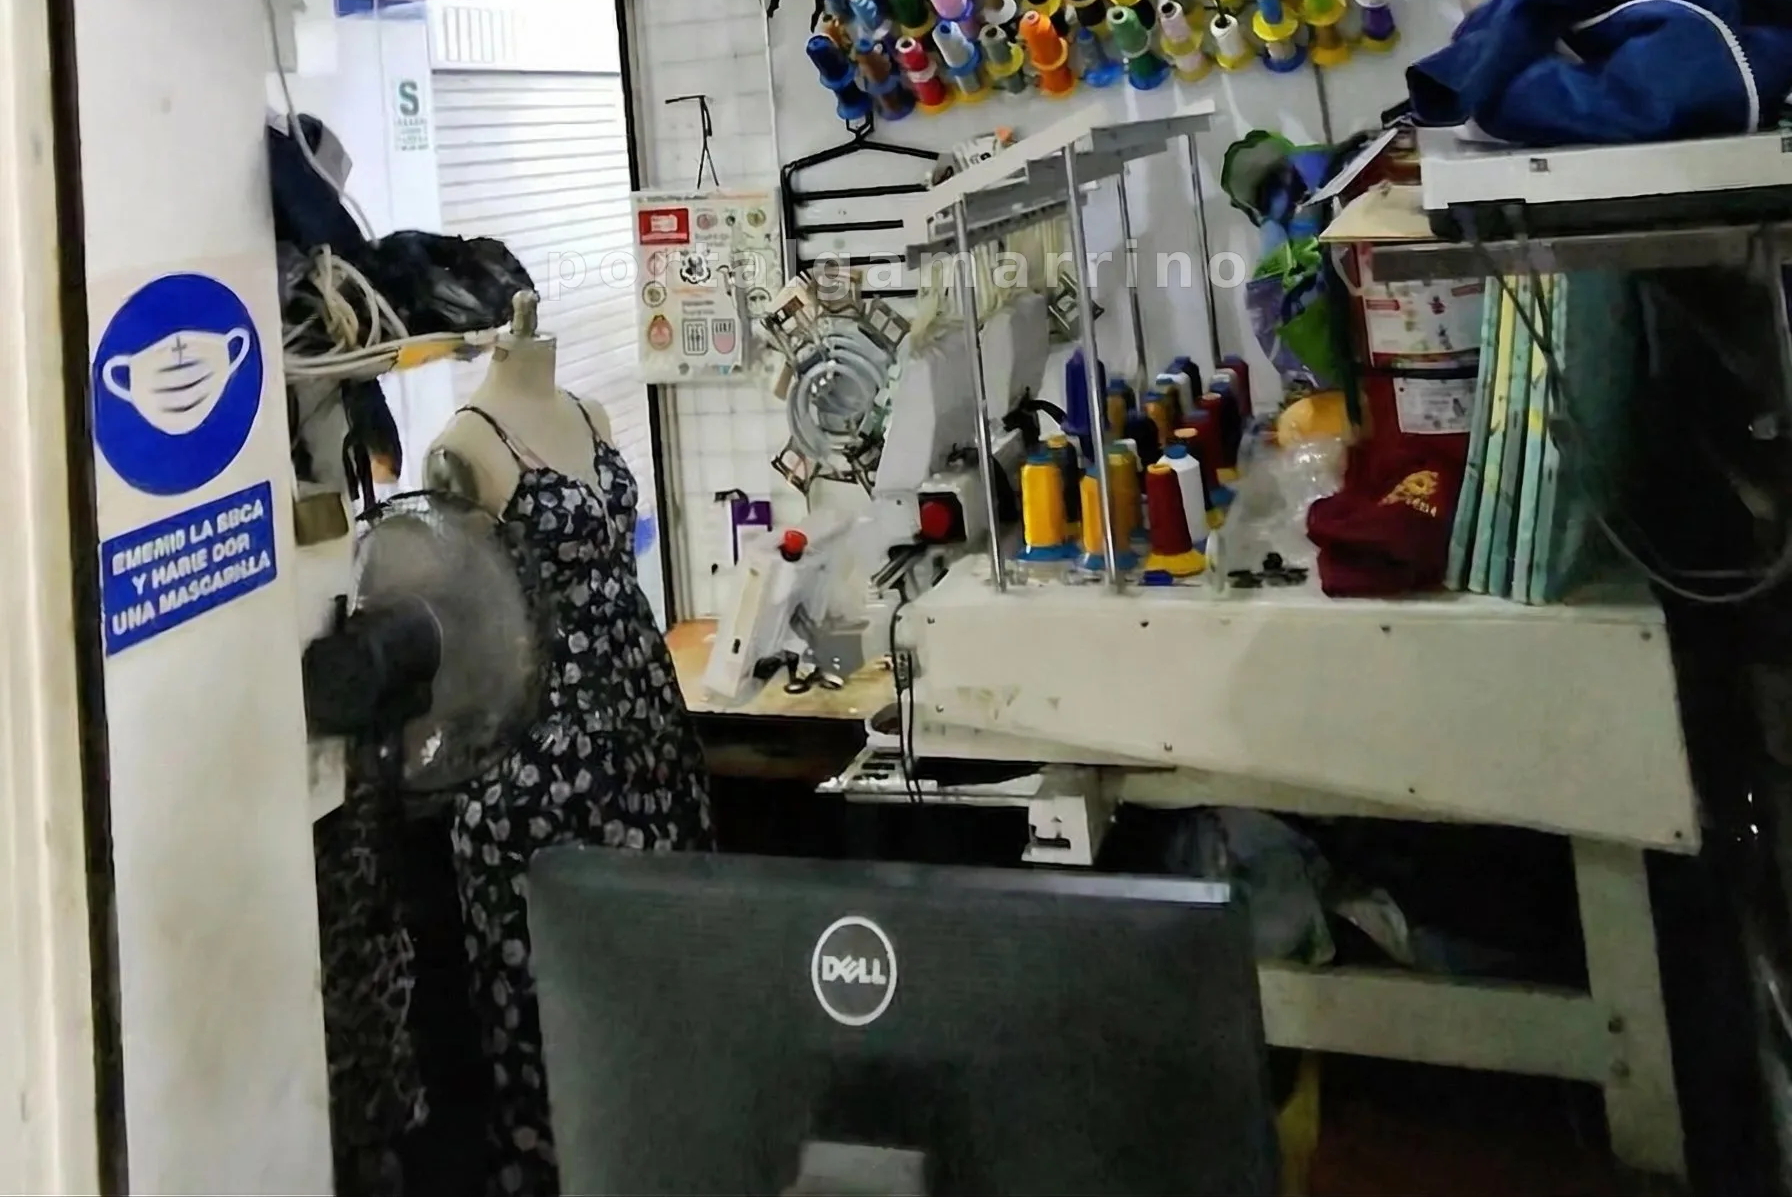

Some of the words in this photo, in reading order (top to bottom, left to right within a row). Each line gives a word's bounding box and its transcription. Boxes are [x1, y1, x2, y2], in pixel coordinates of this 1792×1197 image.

[398, 80, 419, 116] S
[189, 519, 214, 544] LA
[131, 572, 147, 595] Y
[821, 955, 887, 985] DELL
